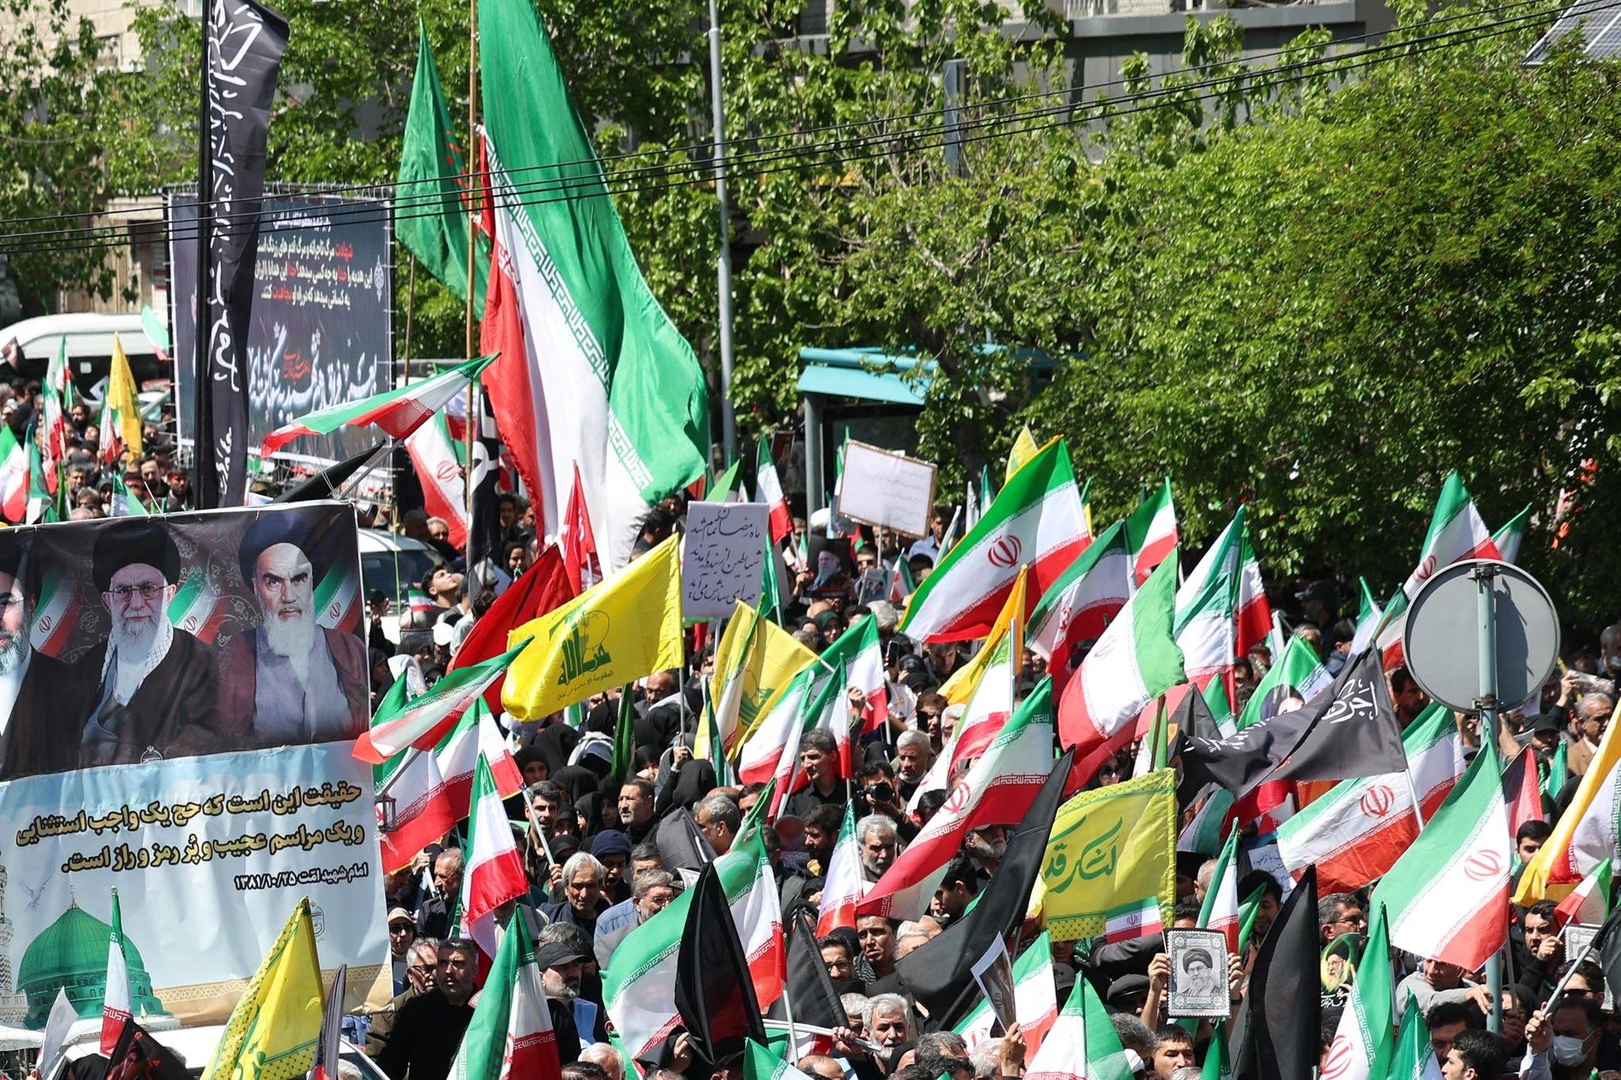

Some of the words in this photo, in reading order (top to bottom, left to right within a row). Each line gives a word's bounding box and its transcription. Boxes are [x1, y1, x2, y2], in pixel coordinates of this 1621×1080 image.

[202, 793, 225, 816] که
[226, 788, 271, 815] است
[272, 786, 301, 815] این
[302, 781, 362, 809] حقیقت
[88, 804, 139, 836] واجب
[140, 800, 170, 827] یک
[171, 800, 201, 826] حج
[16, 809, 87, 847] استثنایی
[269, 823, 324, 855] مراسم
[324, 819, 352, 846] یک
[354, 824, 365, 844] و
[111, 842, 136, 872] راز
[137, 848, 149, 868] و
[150, 842, 180, 867] رمز
[201, 841, 213, 861] و
[212, 832, 268, 858] عجیب
[321, 865, 347, 884] شهید
[347, 862, 369, 883] امام
